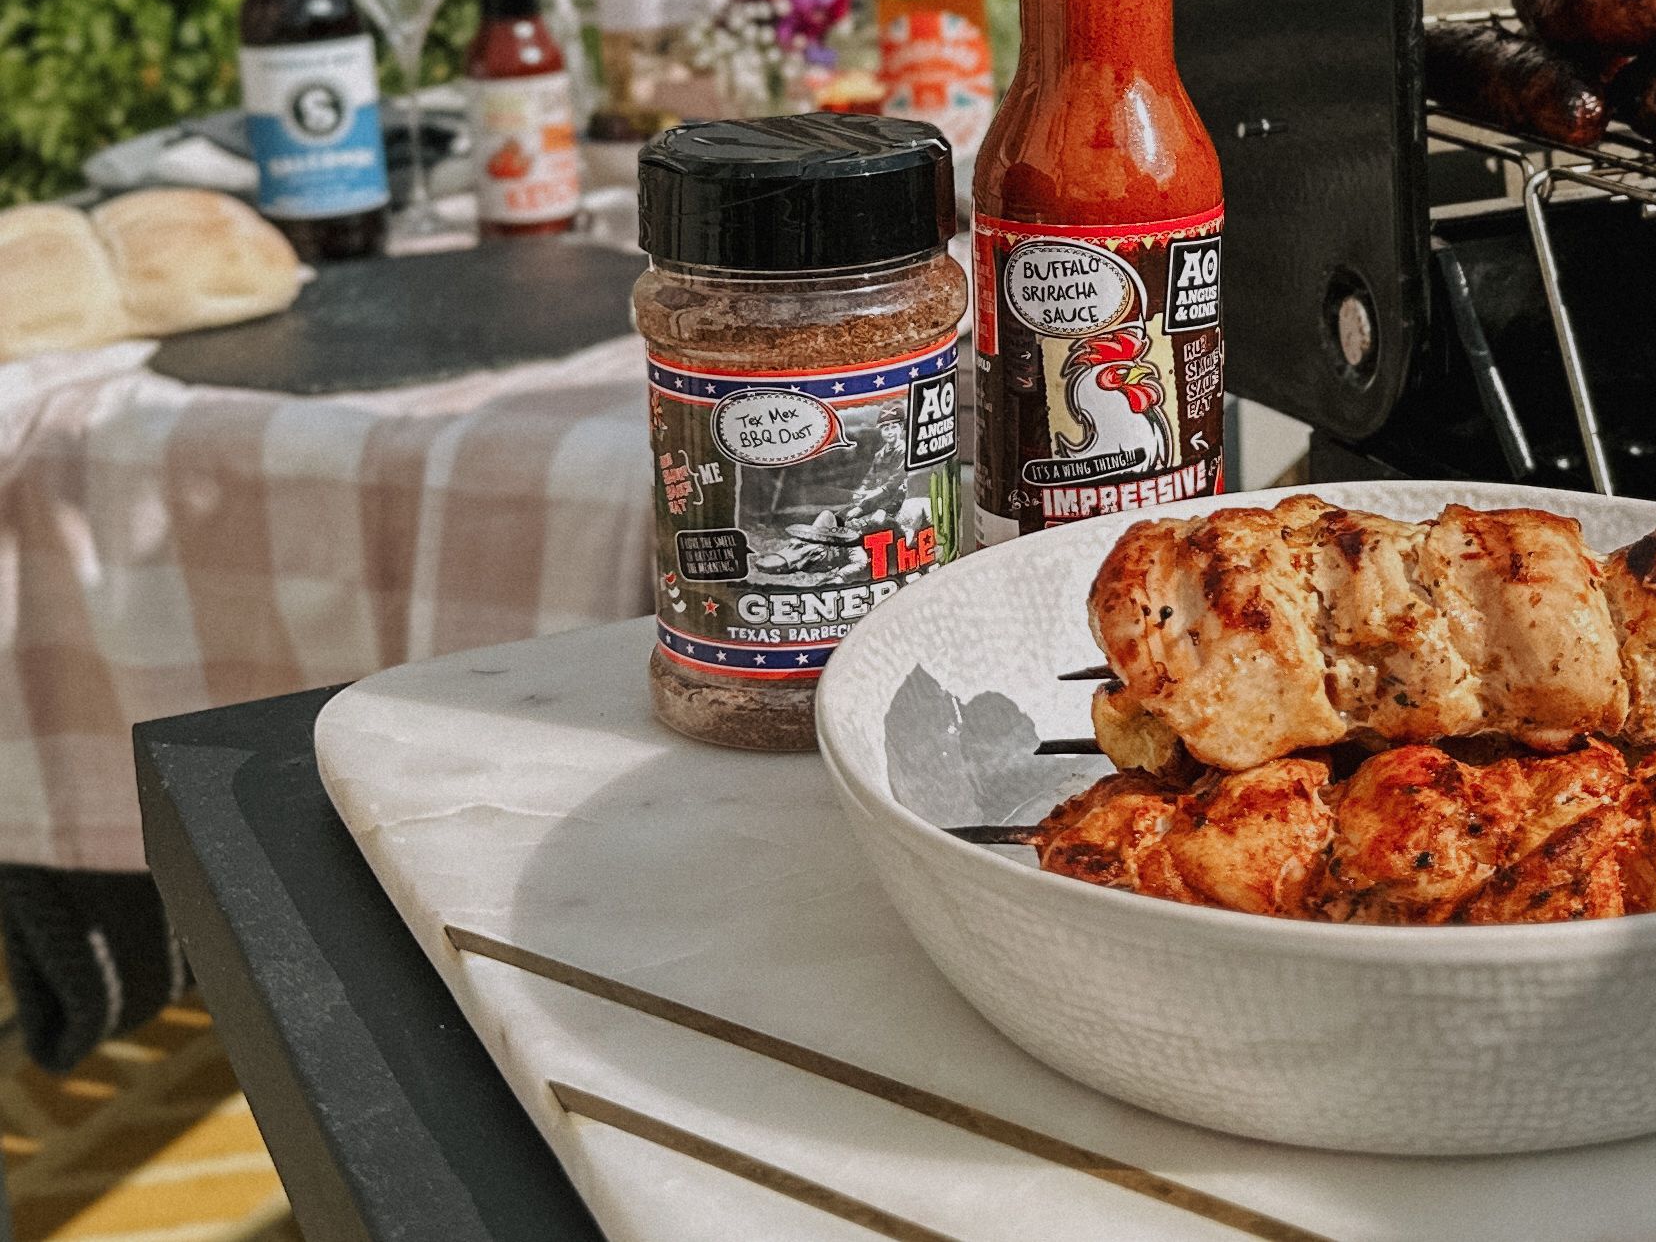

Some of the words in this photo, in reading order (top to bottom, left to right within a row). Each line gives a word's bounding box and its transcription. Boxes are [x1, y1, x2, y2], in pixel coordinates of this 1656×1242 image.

[1024, 259, 1099, 280] BUFFALO
[1022, 282, 1097, 302] SRIRACHA
[1176, 285, 1218, 306] ANGUS
[1043, 306, 1099, 324] SAUCE
[1175, 309, 1188, 321] &
[1189, 302, 1217, 319] OINK
[736, 414, 763, 429] Tex
[768, 408, 800, 424] Mex
[917, 416, 955, 440] ANGUS
[739, 429, 776, 448] BBQ
[929, 432, 954, 451] OINK
[698, 461, 721, 485] ME
[1053, 466, 1061, 478] A
[1062, 462, 1091, 476] WING
[1094, 450, 1137, 472] THING!!!
[1042, 460, 1207, 518] IMPRESSIVE
[726, 626, 781, 644] TEXAS
